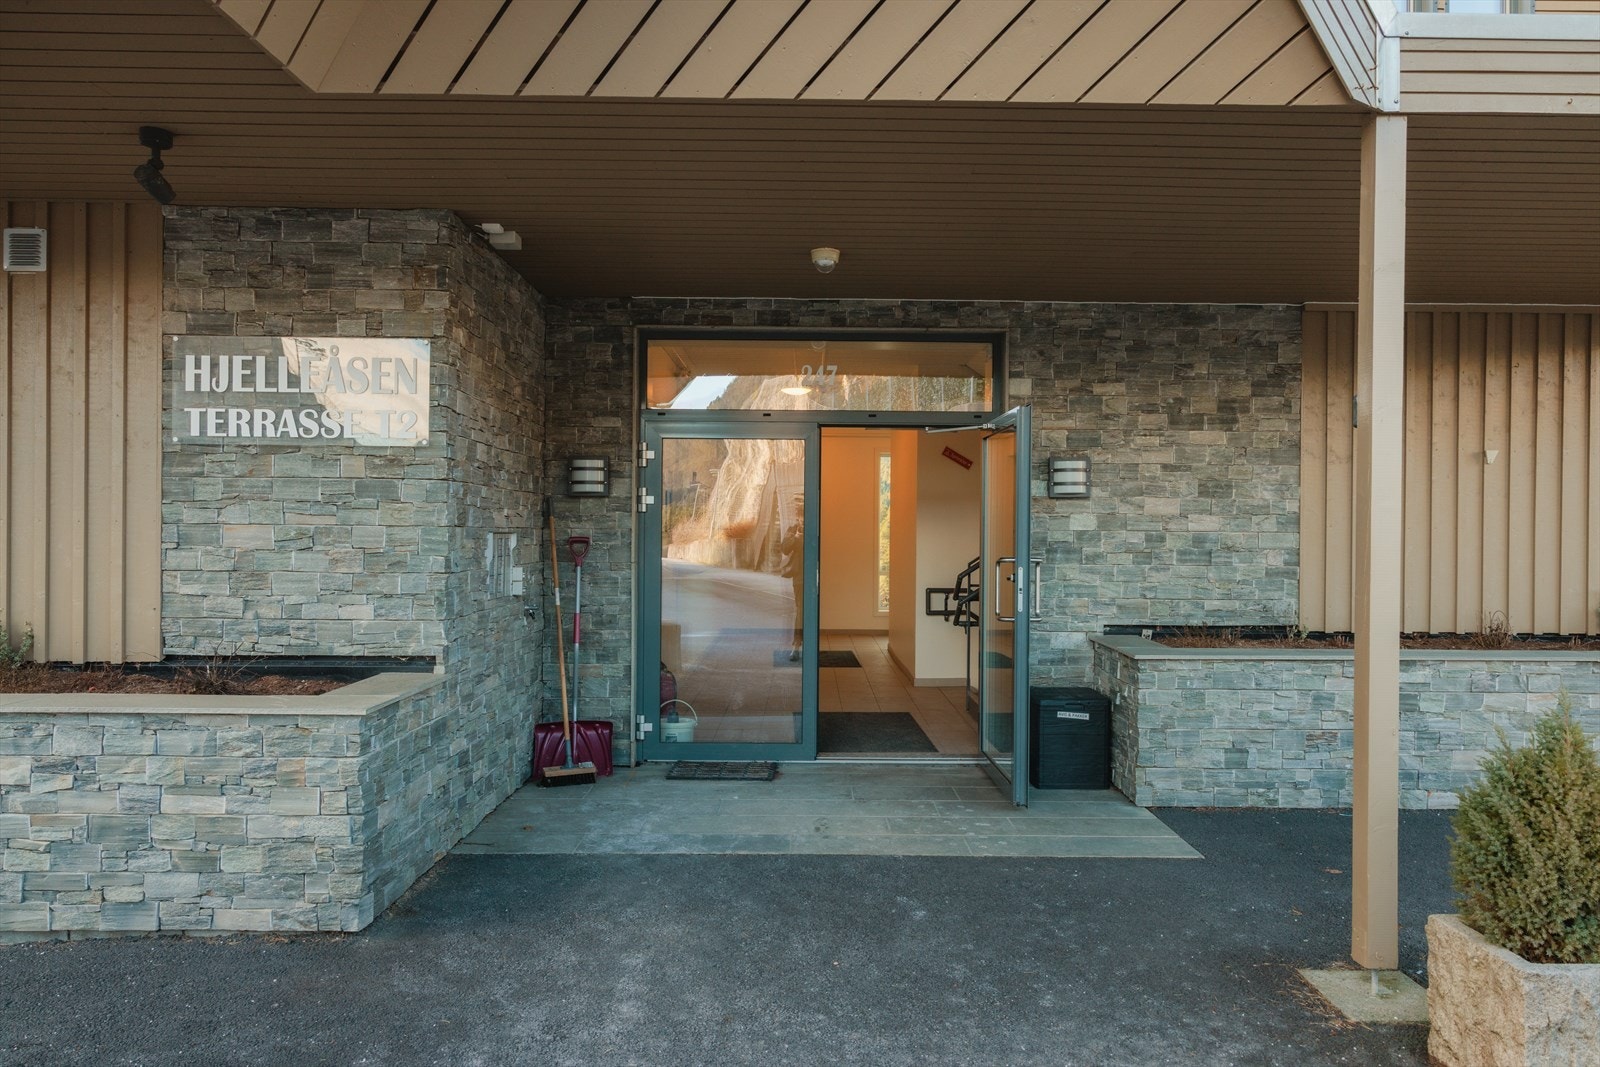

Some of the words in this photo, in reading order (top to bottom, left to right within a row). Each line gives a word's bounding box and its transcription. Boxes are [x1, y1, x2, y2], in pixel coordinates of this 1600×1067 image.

[185, 344, 418, 395] HJELLEÅSEN
[801, 364, 838, 386] 247
[184, 407, 363, 439] TERRASSE
[375, 410, 418, 439] T2
